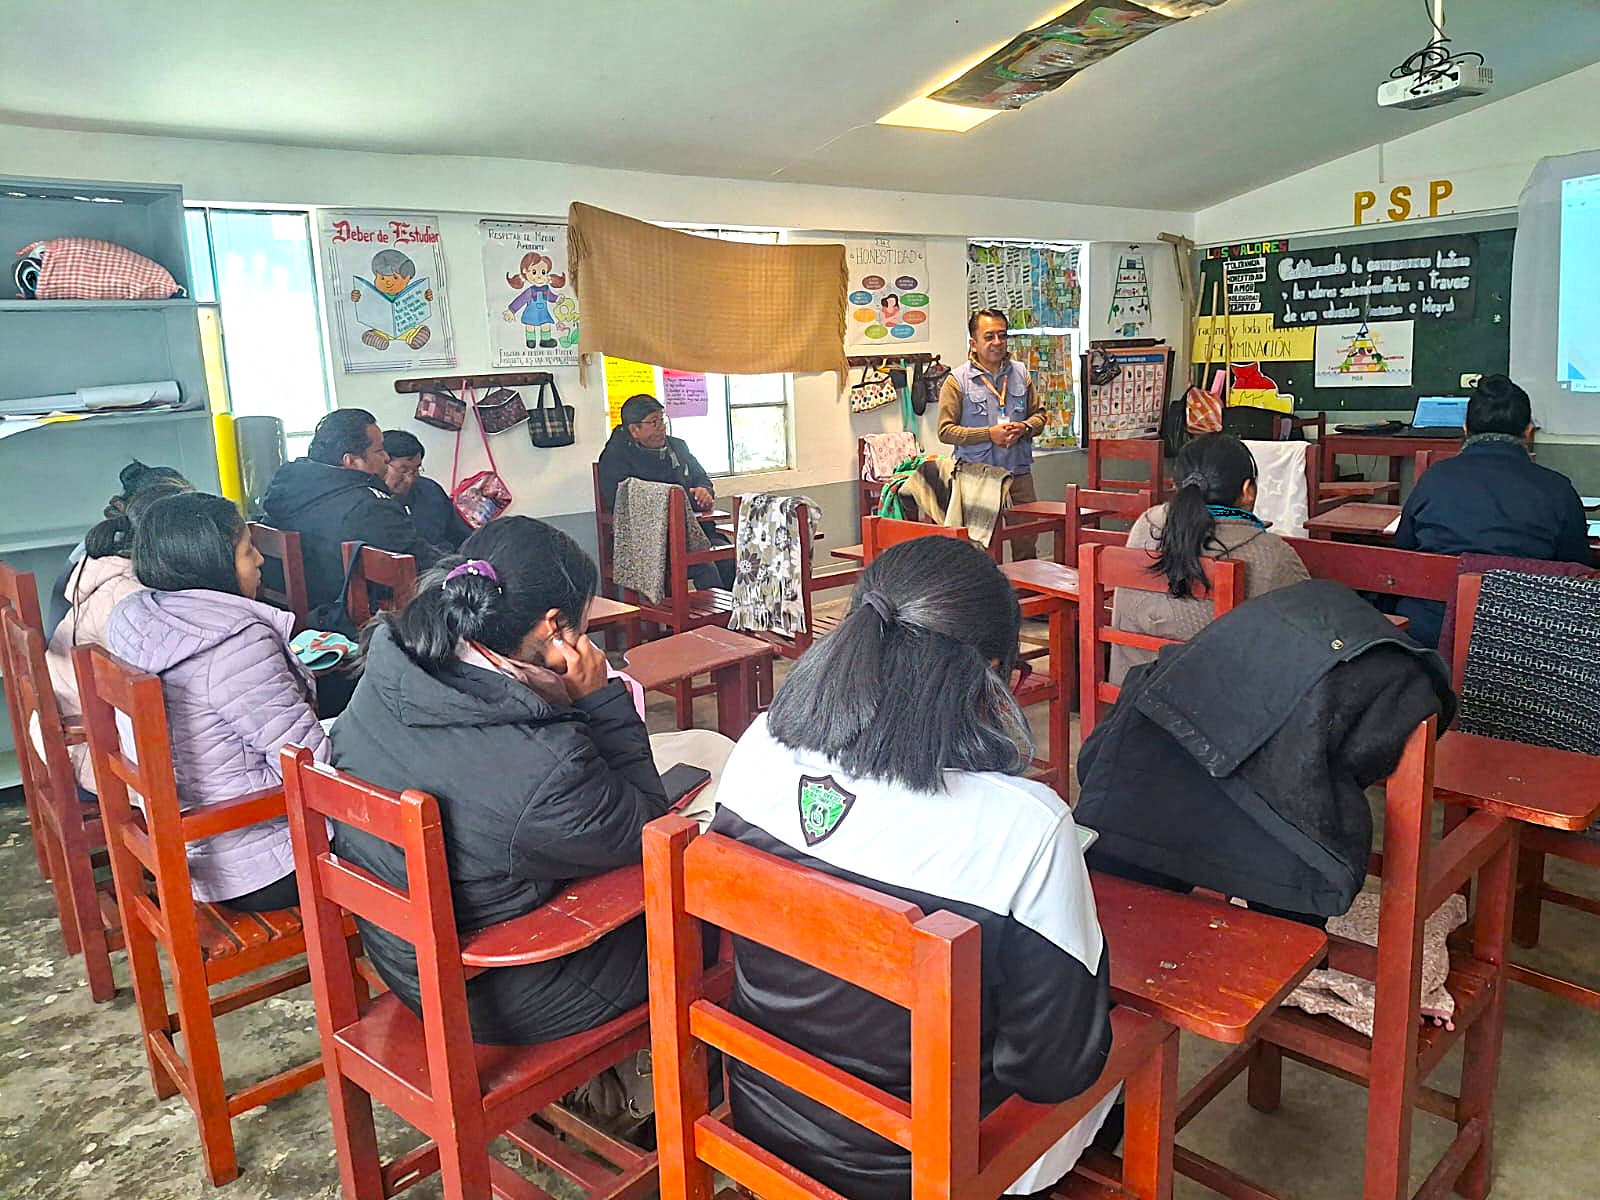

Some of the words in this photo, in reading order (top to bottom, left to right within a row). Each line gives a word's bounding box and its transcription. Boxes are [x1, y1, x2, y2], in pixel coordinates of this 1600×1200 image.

[332, 220, 374, 244] Deber
[377, 230, 388, 243] de
[1206, 247, 1229, 260] LOS
[1232, 240, 1288, 256] VALORES
[1283, 303, 1297, 323] de
